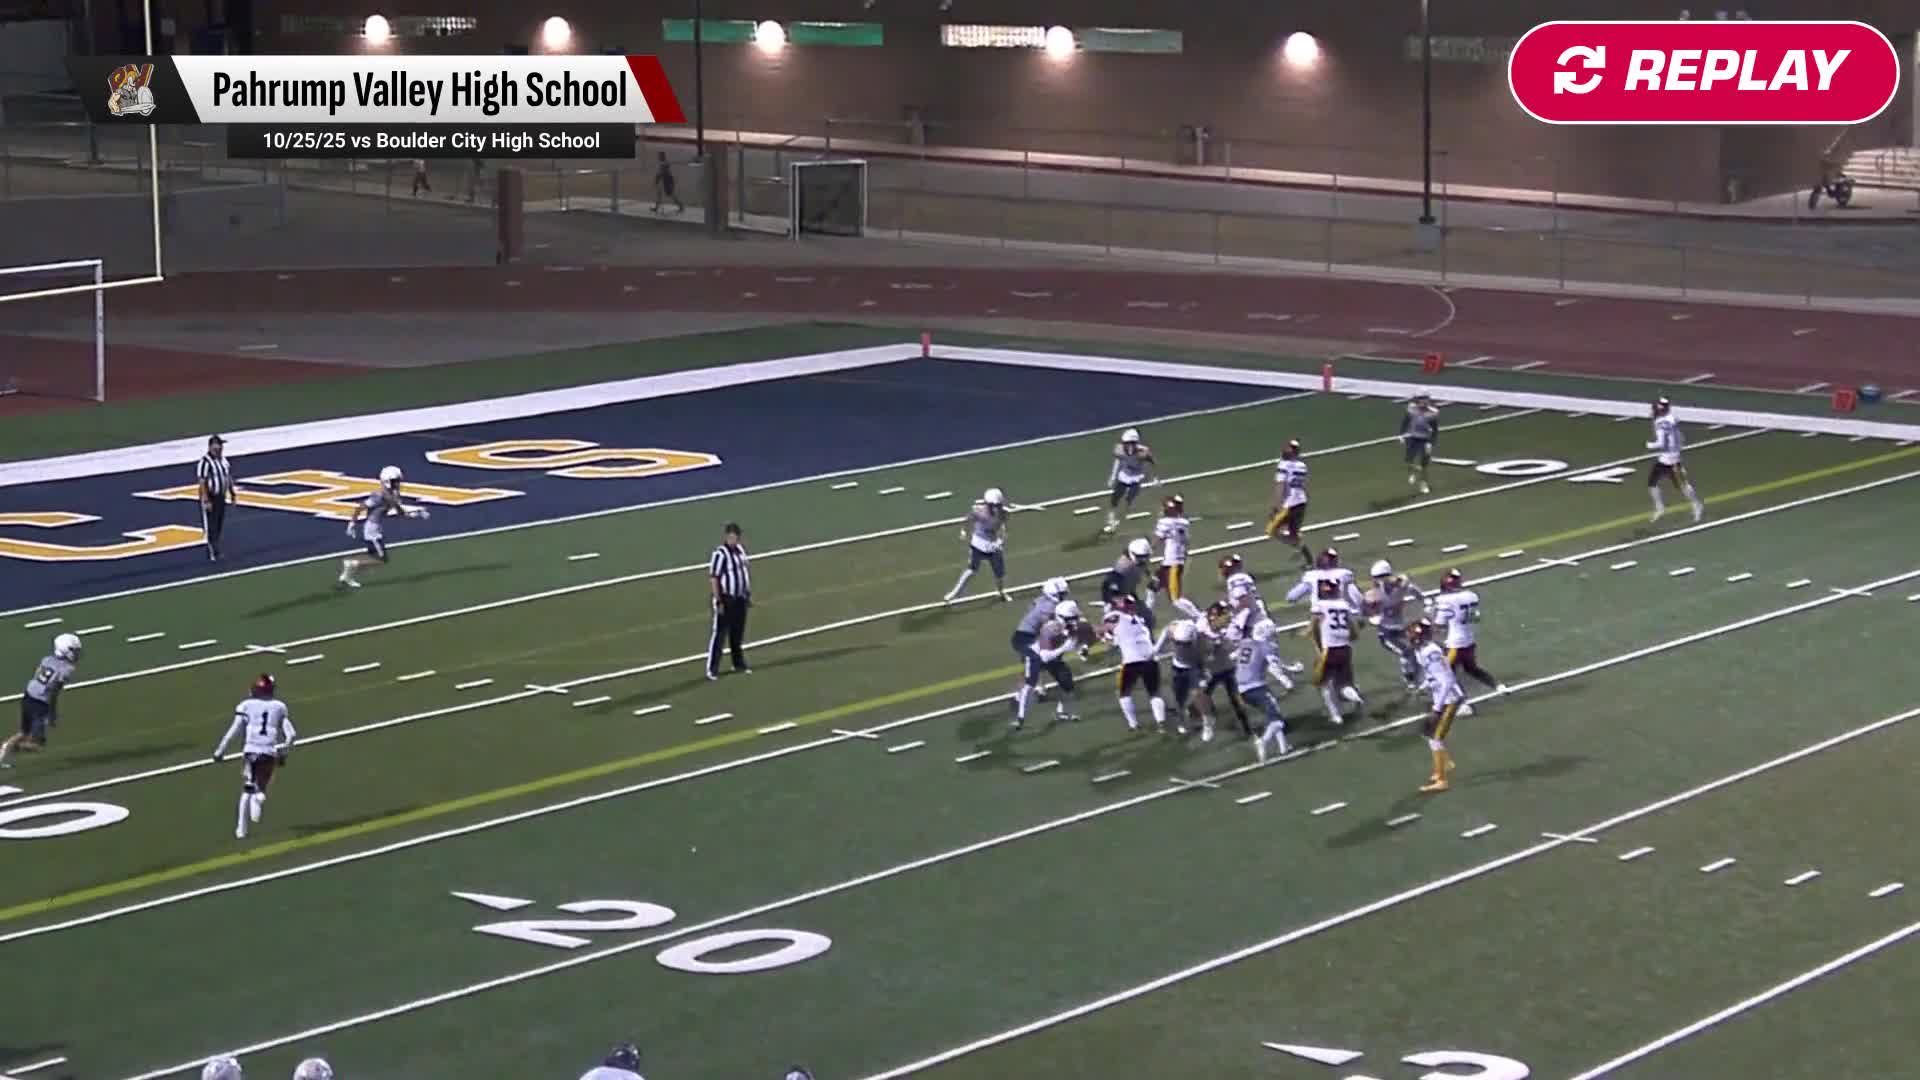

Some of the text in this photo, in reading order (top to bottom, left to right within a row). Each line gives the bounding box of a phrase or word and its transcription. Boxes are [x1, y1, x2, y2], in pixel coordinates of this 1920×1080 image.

[1326, 608, 1350, 630] 33
[259, 710, 270, 736] 1
[473, 899, 831, 975] 20
